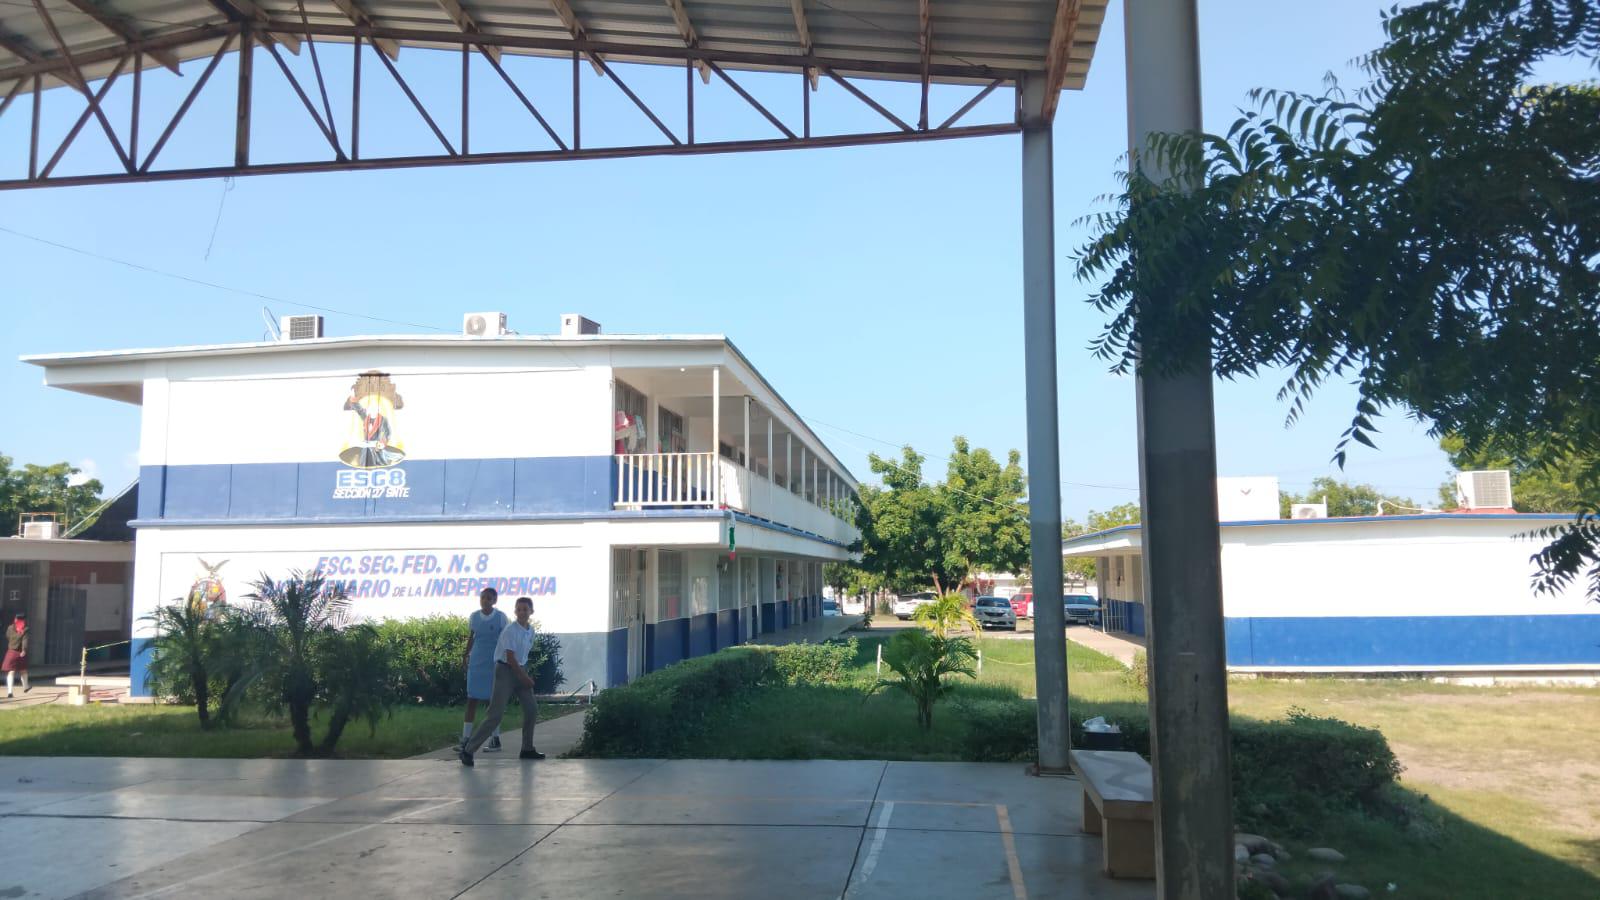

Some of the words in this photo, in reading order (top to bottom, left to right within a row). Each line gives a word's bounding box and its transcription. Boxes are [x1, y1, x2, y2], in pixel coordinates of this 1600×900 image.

[313, 556, 355, 575] ESC.
[358, 555, 399, 575] SEC.
[401, 554, 441, 574] FED.
[448, 554, 471, 574] N.
[475, 553, 489, 573] 8
[392, 585, 407, 597] DE
[408, 585, 422, 597] LA
[424, 576, 557, 597] INDEPENDENCIA
